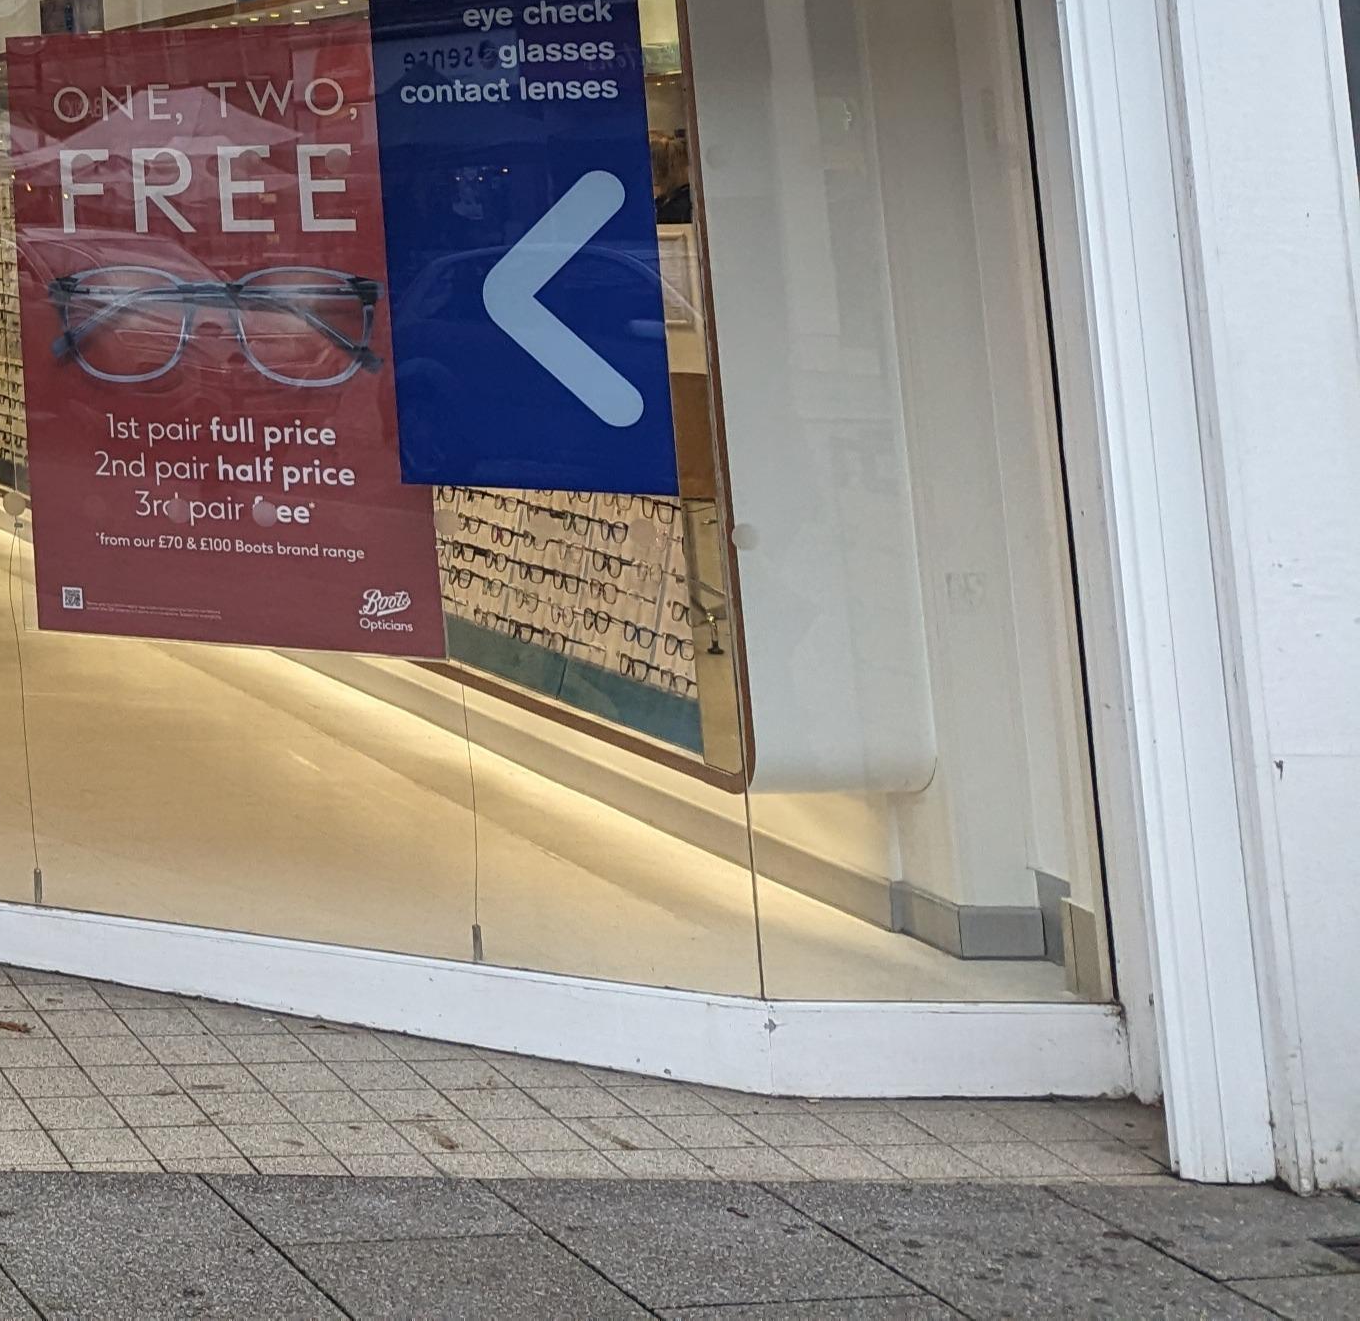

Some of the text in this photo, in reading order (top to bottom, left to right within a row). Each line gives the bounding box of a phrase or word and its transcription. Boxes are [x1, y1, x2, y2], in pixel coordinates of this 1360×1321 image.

[463, 7, 513, 32] eye
[498, 38, 615, 68] glasses
[53, 83, 184, 125] ONE,
[207, 78, 357, 121] TWO,
[400, 78, 619, 104] contact lenses
[58, 143, 357, 234] FREE
[106, 413, 337, 451] 1st pair full price
[94, 451, 355, 491] 2nd pair half price
[189, 496, 245, 526] pair
[133, 536, 156, 548] our
[158, 535, 183, 550] £70
[186, 538, 198, 551] &
[200, 537, 231, 553] £100
[235, 539, 274, 555] Boots
[277, 541, 319, 558] brand
[322, 545, 366, 563] range
[359, 589, 412, 617] Boots
[359, 618, 414, 632] Opticians
